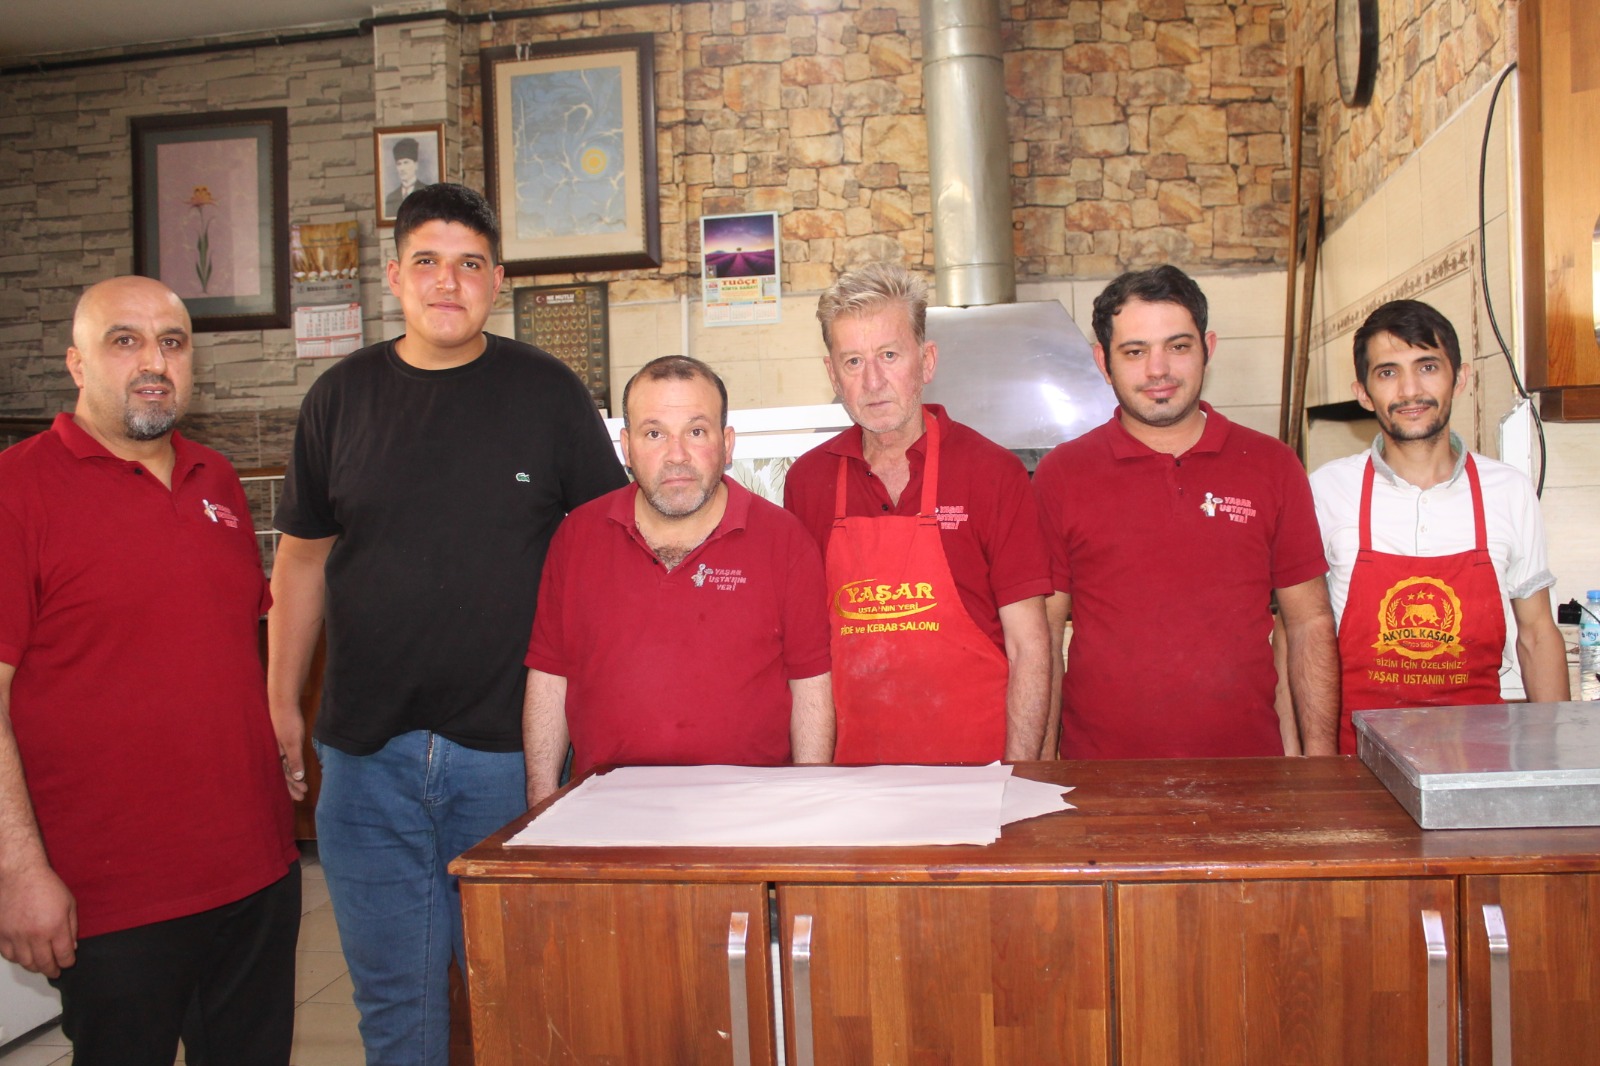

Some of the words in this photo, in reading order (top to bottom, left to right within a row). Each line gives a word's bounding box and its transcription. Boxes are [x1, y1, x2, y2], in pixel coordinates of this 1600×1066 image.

[846, 582, 935, 604] YAŞAR
[867, 623, 898, 634] KEBAB
[899, 621, 940, 632] SALONU
[1382, 628, 1417, 643] AKYOL
[1419, 629, 1455, 644] KASAP
[1368, 670, 1399, 684] YAŞAR
[1403, 674, 1445, 685] USTANIN
